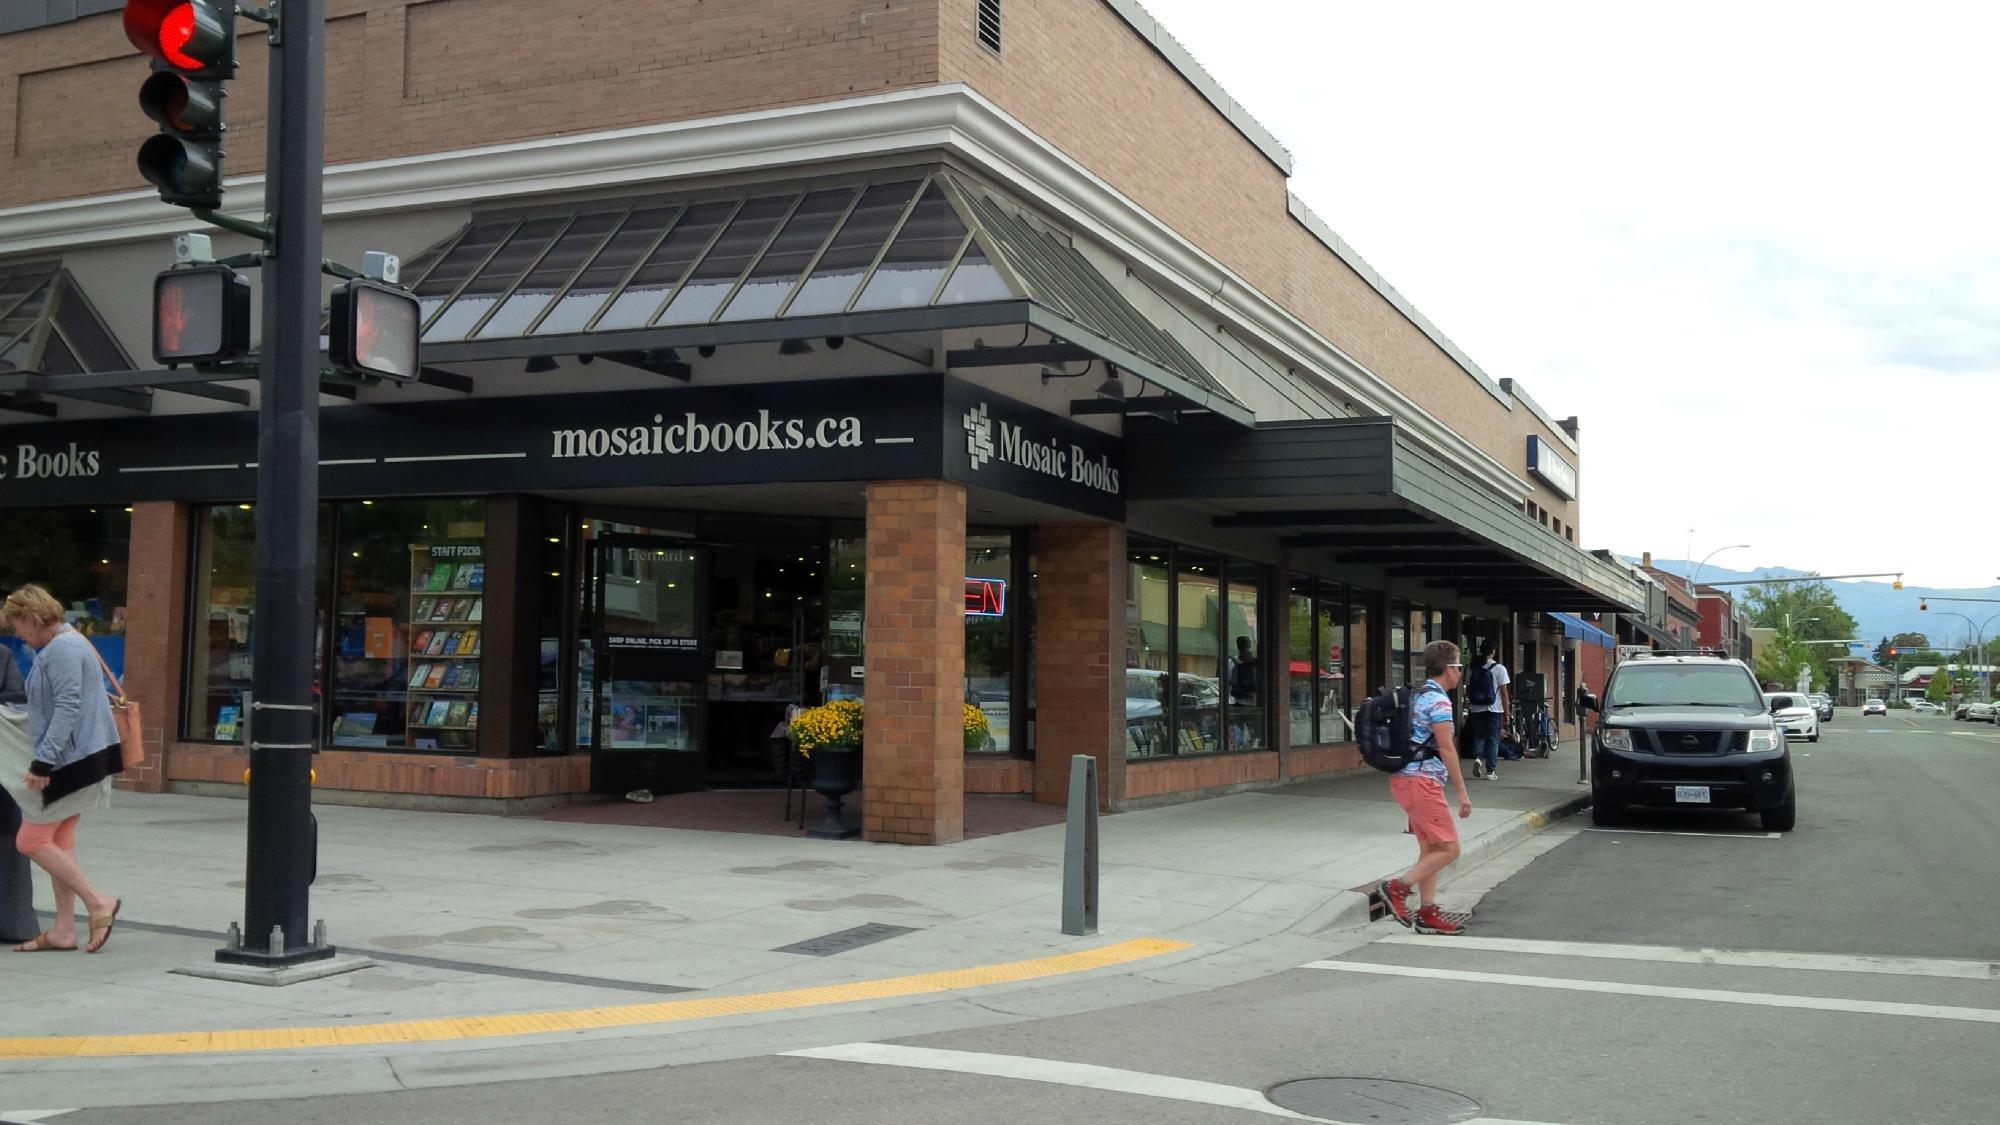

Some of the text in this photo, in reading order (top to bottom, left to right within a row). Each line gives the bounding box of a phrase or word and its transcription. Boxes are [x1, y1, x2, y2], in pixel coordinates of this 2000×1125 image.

[551, 409, 864, 458] mosaicbooks.ca
[15, 442, 100, 479] Books
[998, 420, 1120, 495] Mosaic Books
[431, 545, 481, 557] STAFF PICKS
[965, 581, 1003, 614] EN
